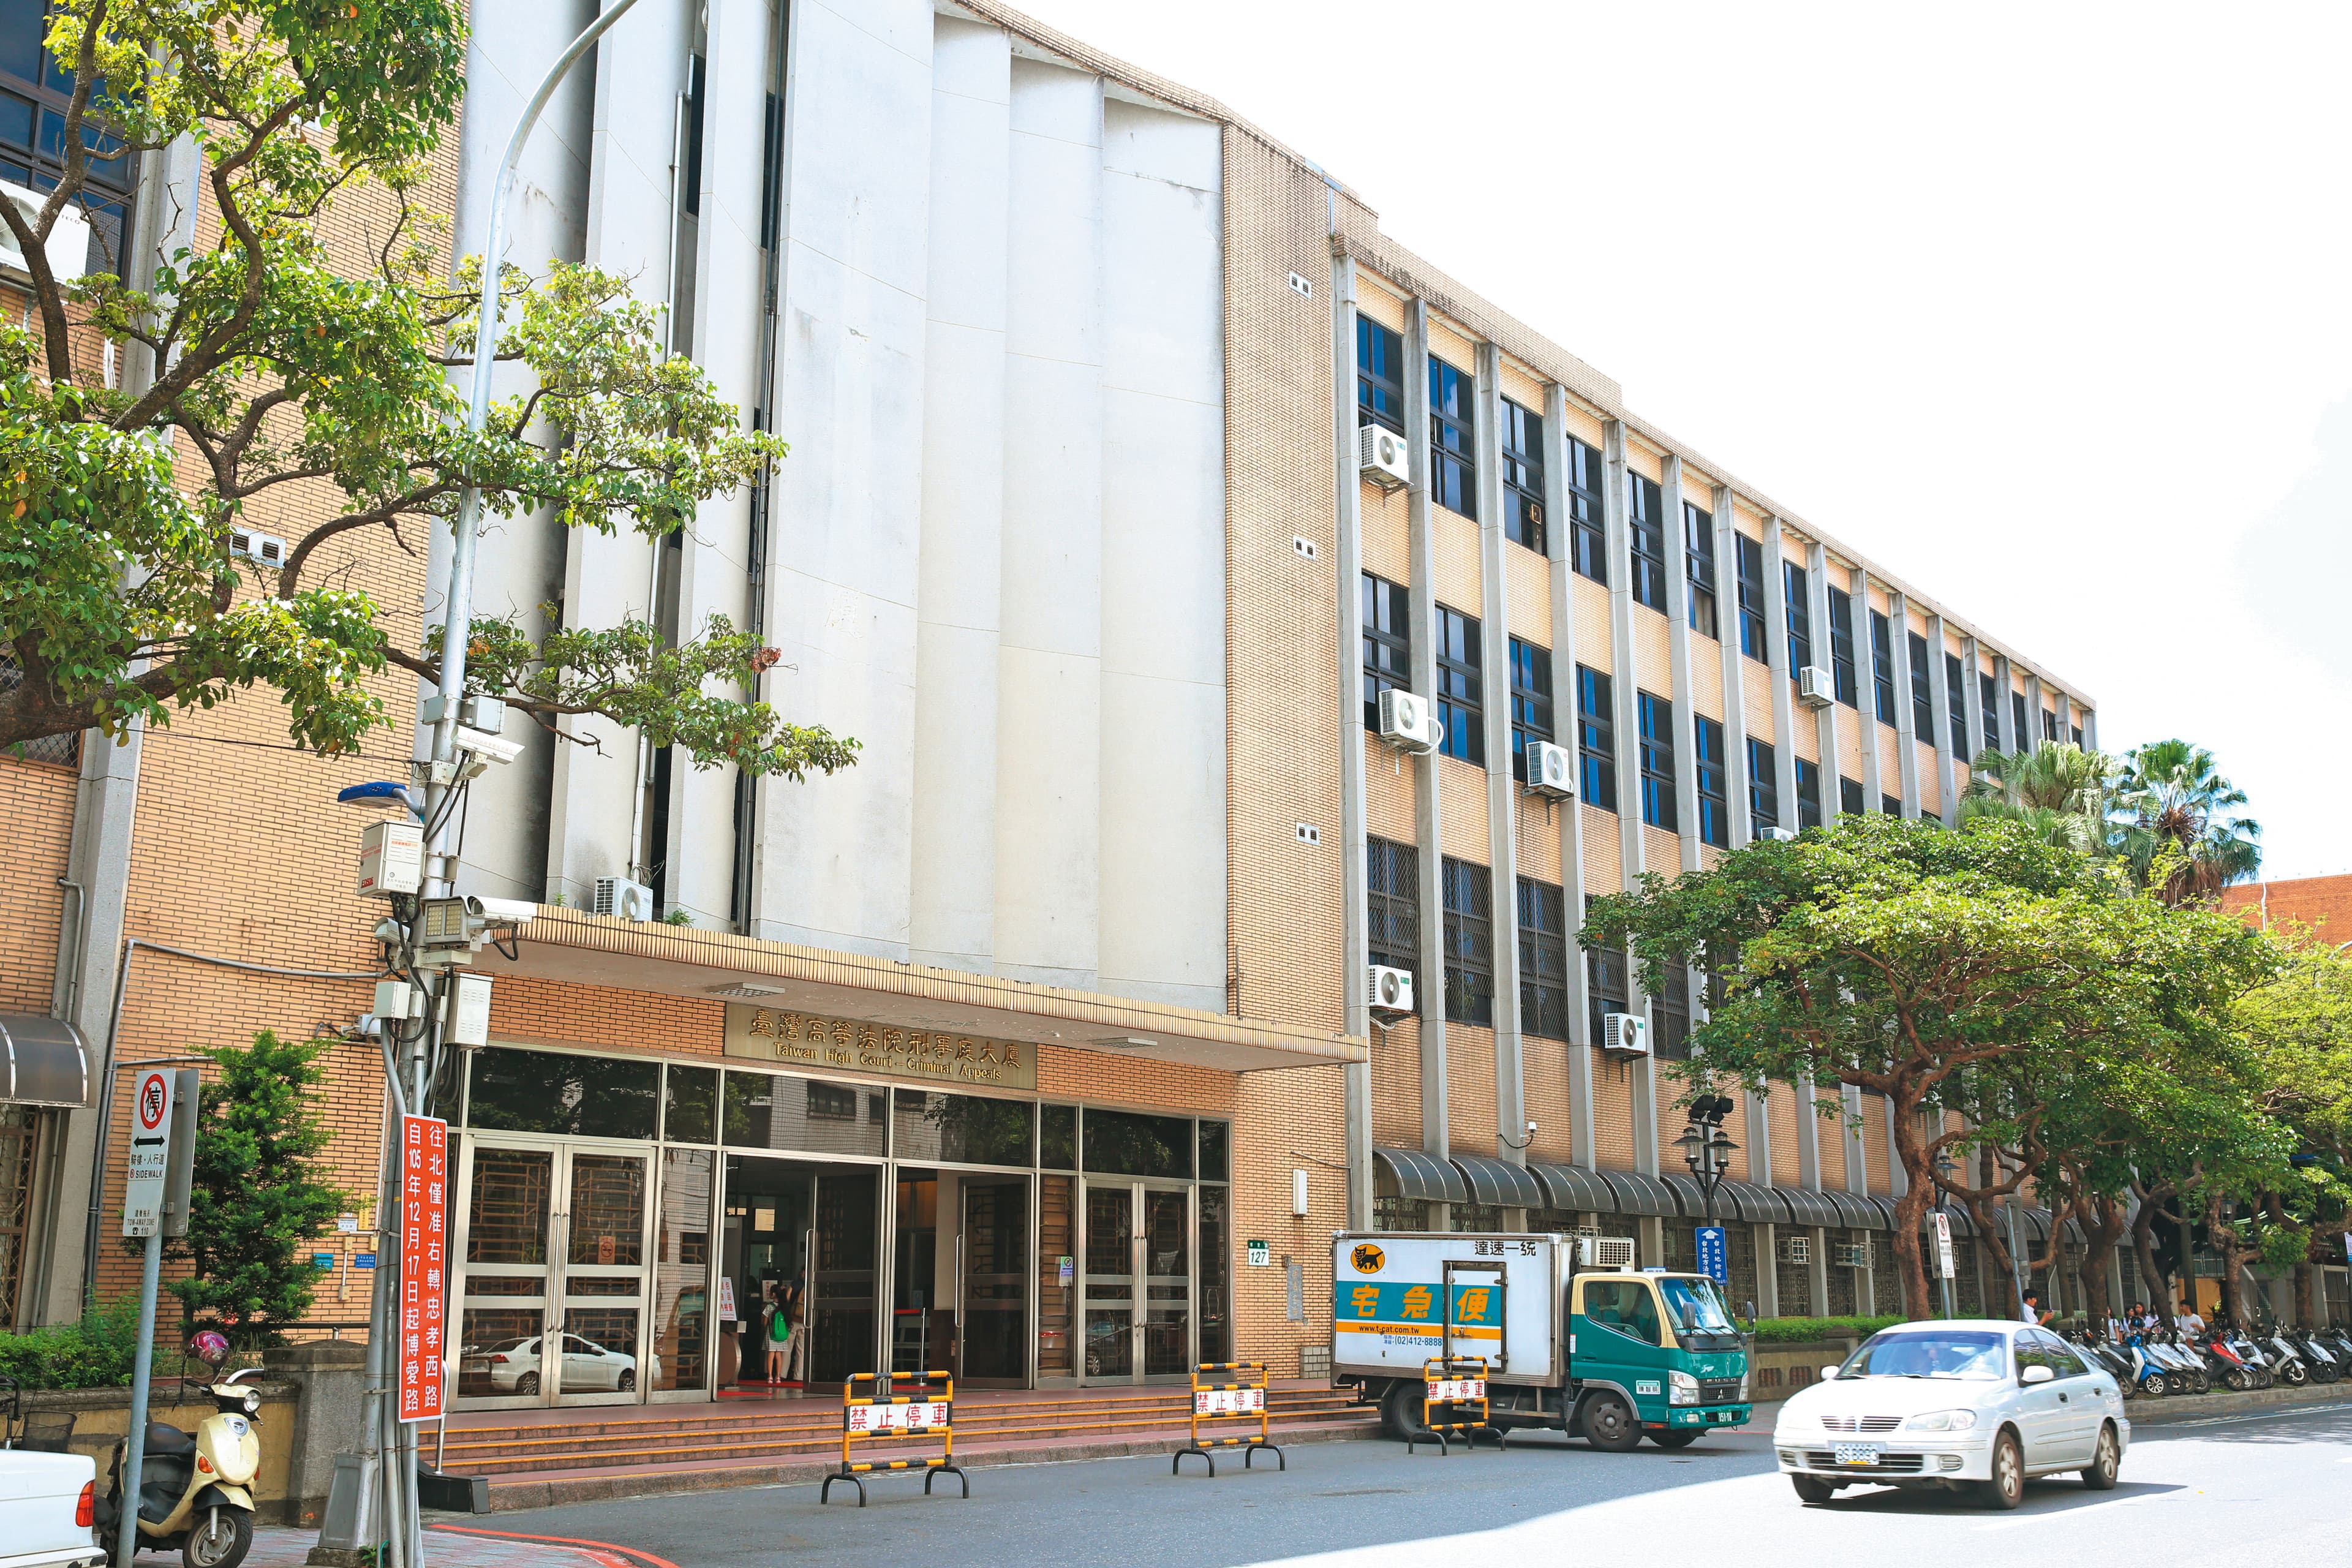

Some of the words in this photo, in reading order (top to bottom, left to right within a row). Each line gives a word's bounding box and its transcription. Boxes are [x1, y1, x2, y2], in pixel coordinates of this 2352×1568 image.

[62, 214, 80, 224] TECO
[749, 1008, 1023, 1069] 臺灣高等法院刑事庭大廈
[774, 1041, 818, 1060] Taiwan
[824, 1047, 853, 1065] High
[860, 1052, 892, 1068] Court
[907, 1058, 952, 1075] Criminal
[959, 1064, 1001, 1081] Appeals
[135, 1169, 163, 1178] SIDEWALK
[404, 1121, 421, 1412] 自105年12月17日起博愛路
[424, 1124, 443, 1408] 往北僅准右轉忠孝西路
[1251, 1251, 1267, 1264] 127
[1350, 1284, 1490, 1322] 宅急便
[1359, 1325, 1420, 1335] www.t-cat.com.tw
[1395, 1335, 1442, 1347] (02)412-8888
[1196, 1389, 1264, 1413] 禁止停車
[1428, 1380, 1483, 1399] 禁止停車
[850, 1403, 948, 1430] 禁止停車
